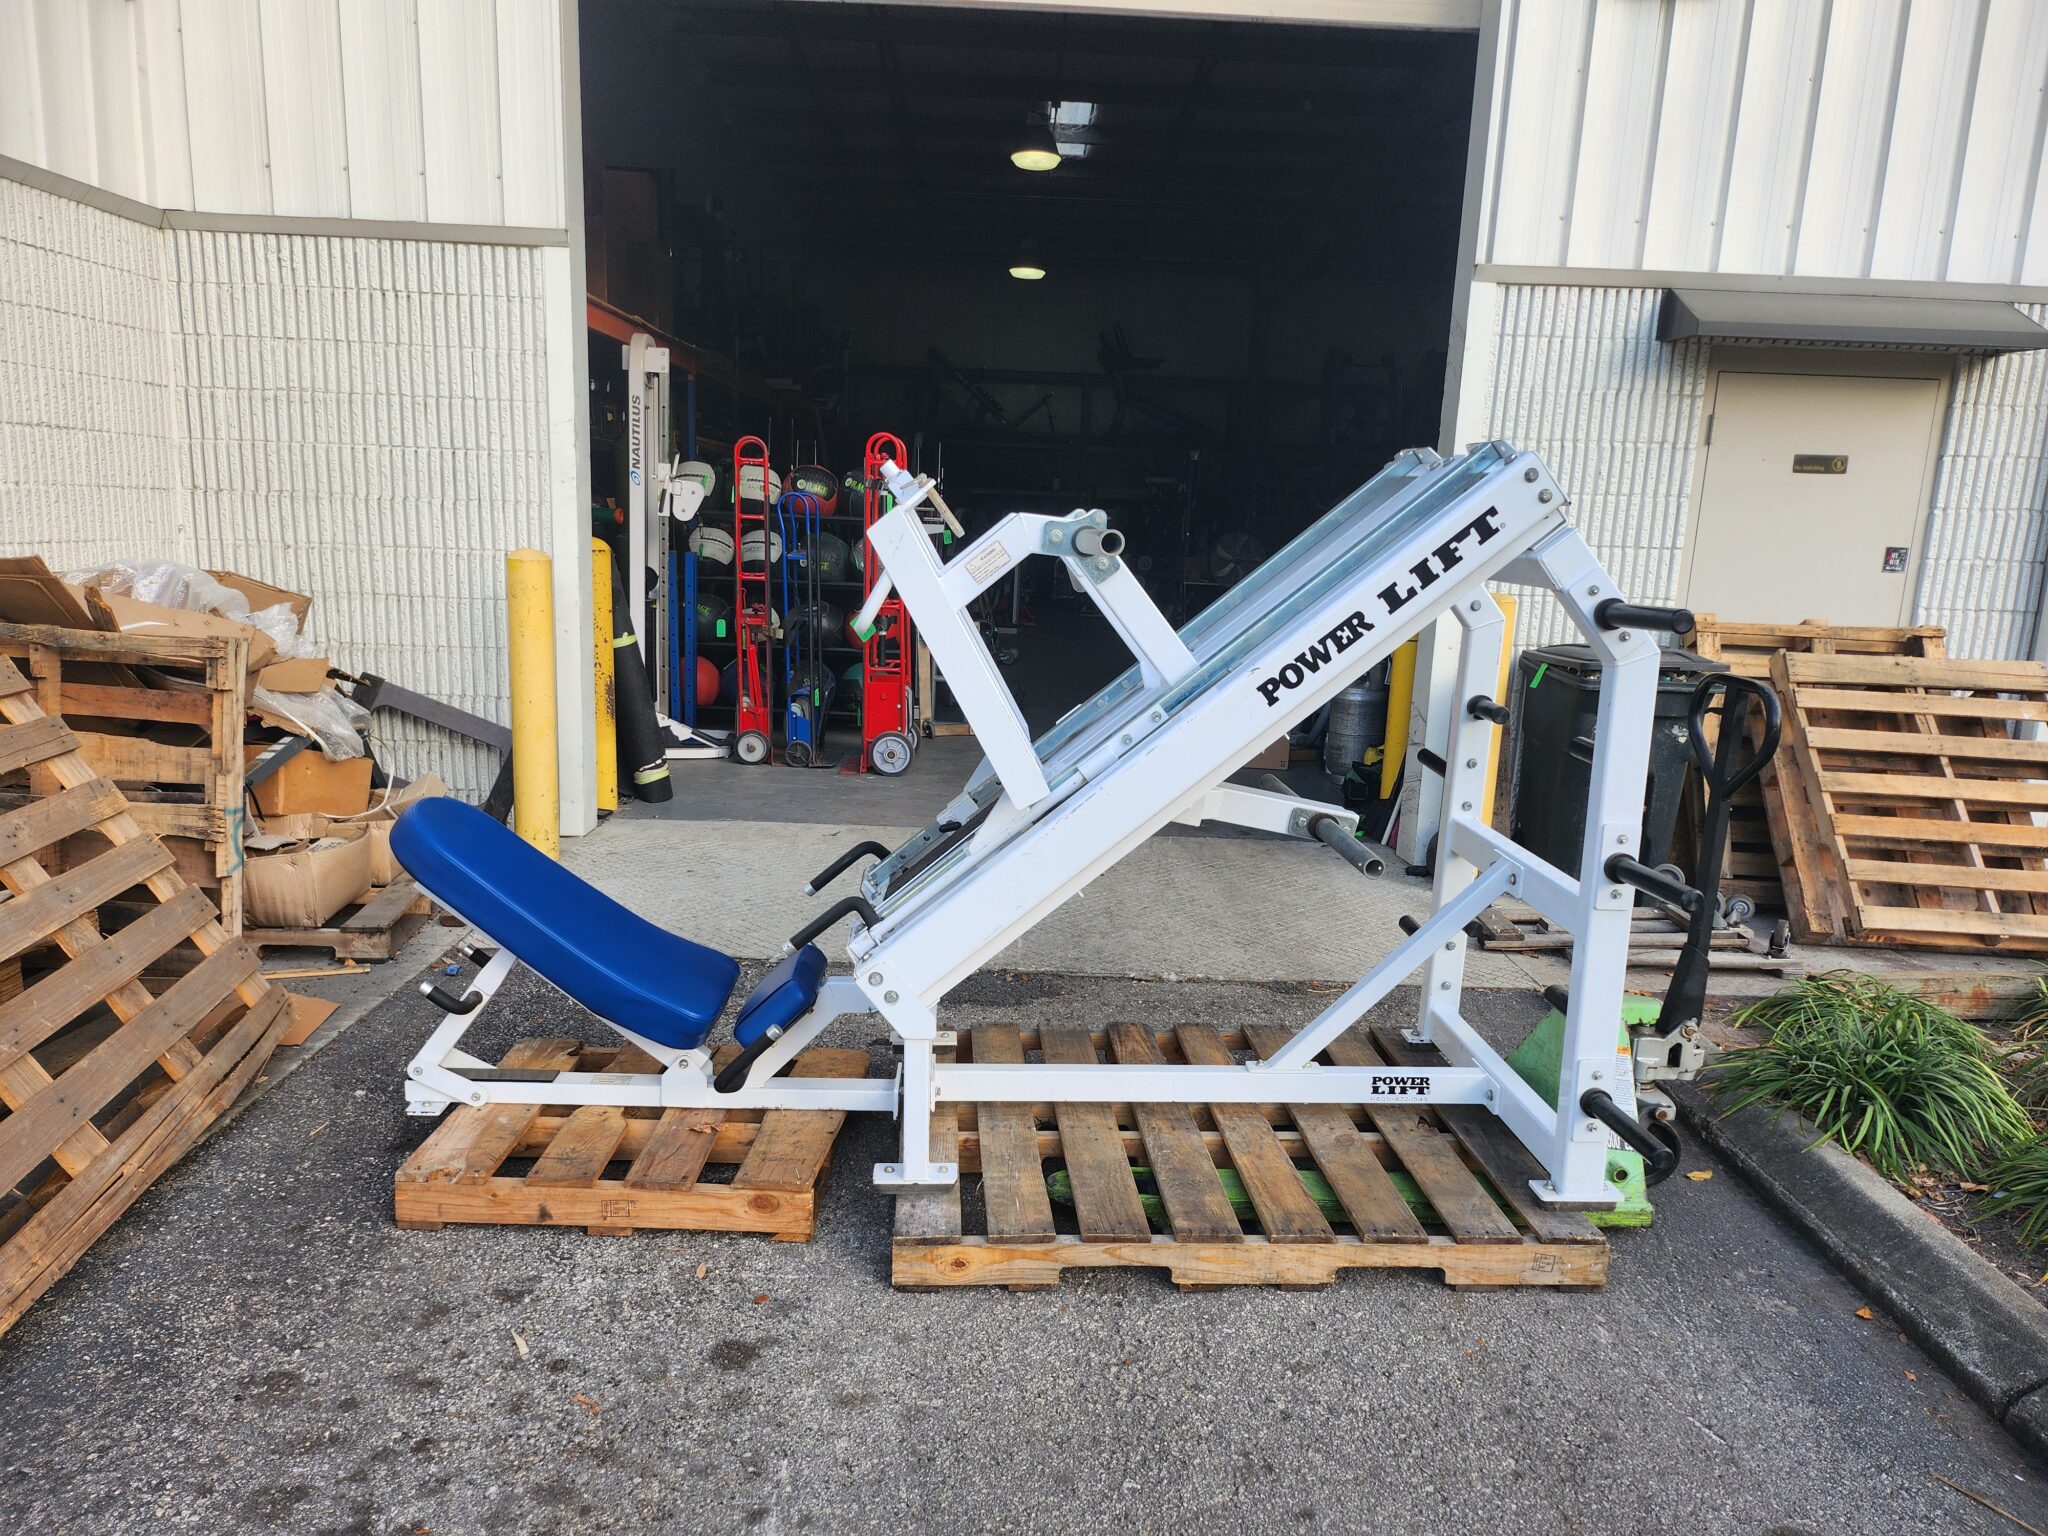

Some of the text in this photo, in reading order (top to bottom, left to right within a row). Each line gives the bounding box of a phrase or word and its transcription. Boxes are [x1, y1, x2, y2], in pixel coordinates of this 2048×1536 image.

[631, 395, 641, 469] NAUTILUS
[1256, 505, 1501, 708] POWER LIFT
[1370, 1085, 1430, 1095] LIFT
[1371, 1076, 1430, 1086] POWER
